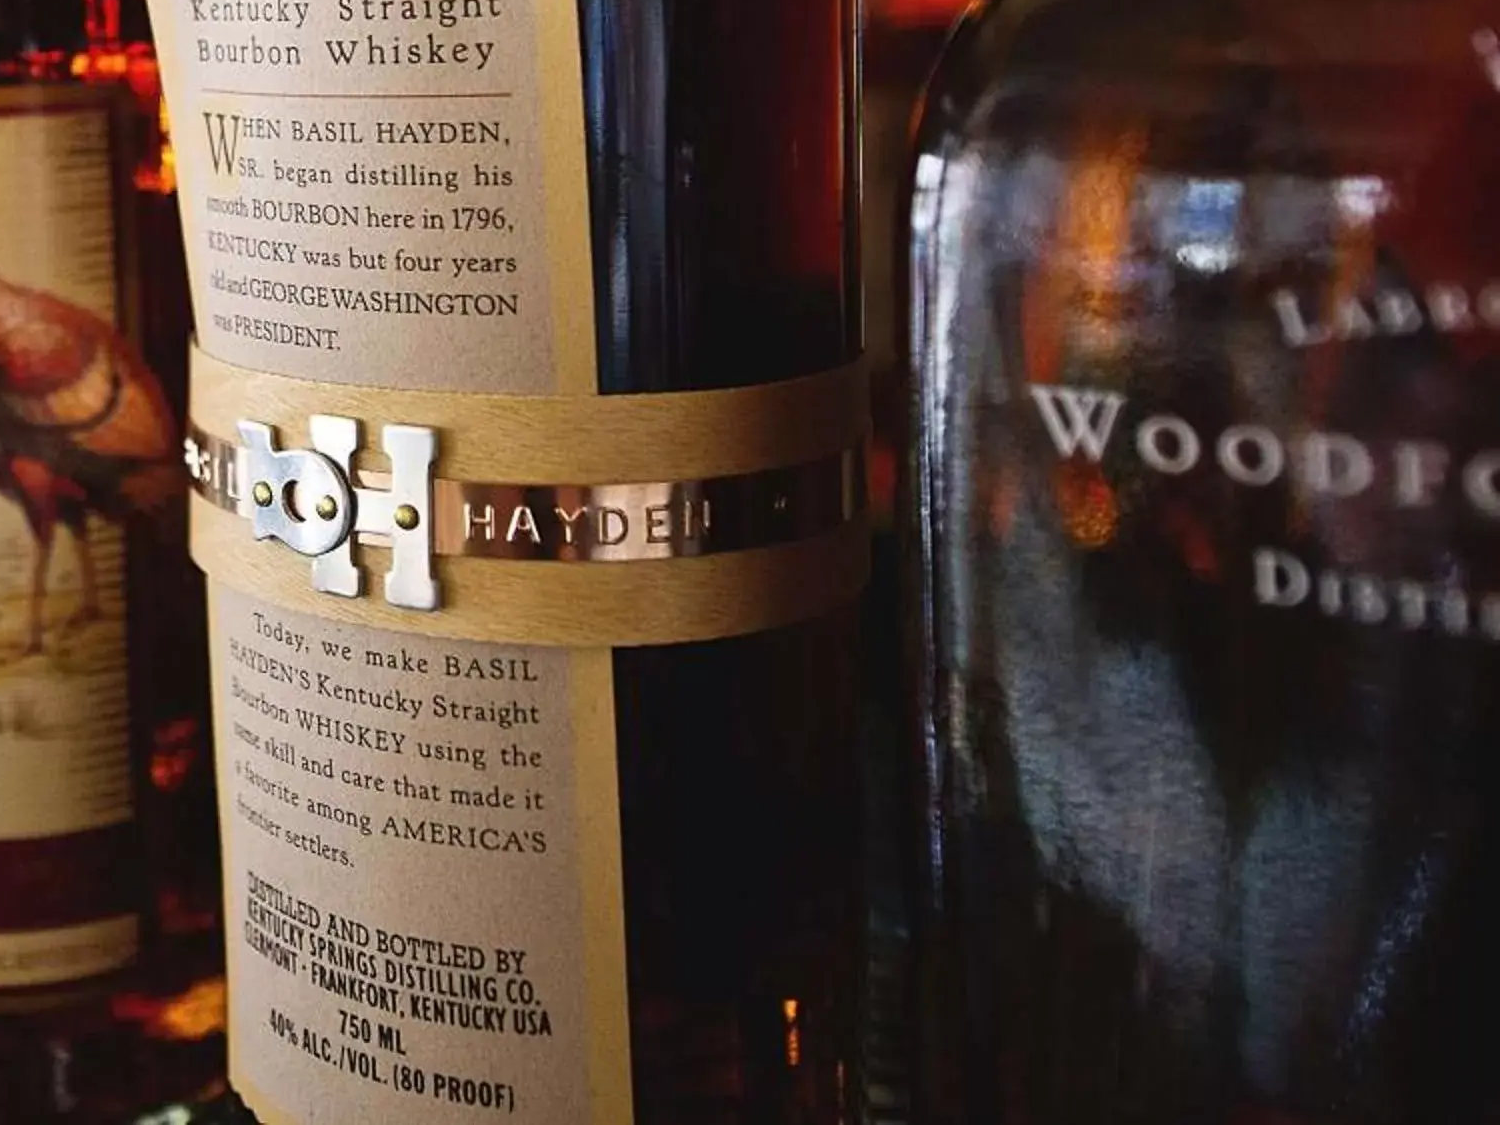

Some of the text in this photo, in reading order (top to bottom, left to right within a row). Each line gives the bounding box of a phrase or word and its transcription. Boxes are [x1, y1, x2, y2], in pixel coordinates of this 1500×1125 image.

[198, 35, 495, 70] Bourbon Whiskey
[202, 112, 510, 177] WHEN BASIL HAYDEN,
[239, 156, 513, 192] SR. began distilling his
[206, 195, 514, 233] smooth BOURBON here in 1796,
[207, 230, 517, 278] KENTUCKY was but four years
[226, 276, 249, 296] and
[250, 279, 330, 308] GEORGE
[332, 289, 518, 315] WASHINGTON
[213, 314, 341, 352] was PRESIDENT.
[253, 613, 538, 682] Today, we make BASIL
[229, 638, 540, 729] HAYDEN'S Kentucky Straight
[230, 678, 542, 769] Bourbon WHISKEY using the
[265, 736, 296, 766] skill
[301, 754, 334, 778] and
[342, 766, 385, 792] care
[393, 778, 441, 802] that
[450, 787, 514, 810] made
[525, 789, 544, 810] it
[244, 762, 299, 805] favorite
[307, 795, 372, 834] among
[381, 816, 546, 853] AMERICA'S
[285, 826, 354, 867] settlers.
[247, 871, 526, 974] DISTILLED AND BOTTLED BY
[247, 896, 541, 1006] KENTUCKY SPRINGS DISTILLING CO.
[245, 921, 552, 1036] CLERMONT FRANKFORT, KENTUCKY USA
[269, 1009, 515, 1112] 40% ALC./VOL. (80 PROOF)
[338, 1009, 406, 1055] 750 ML
